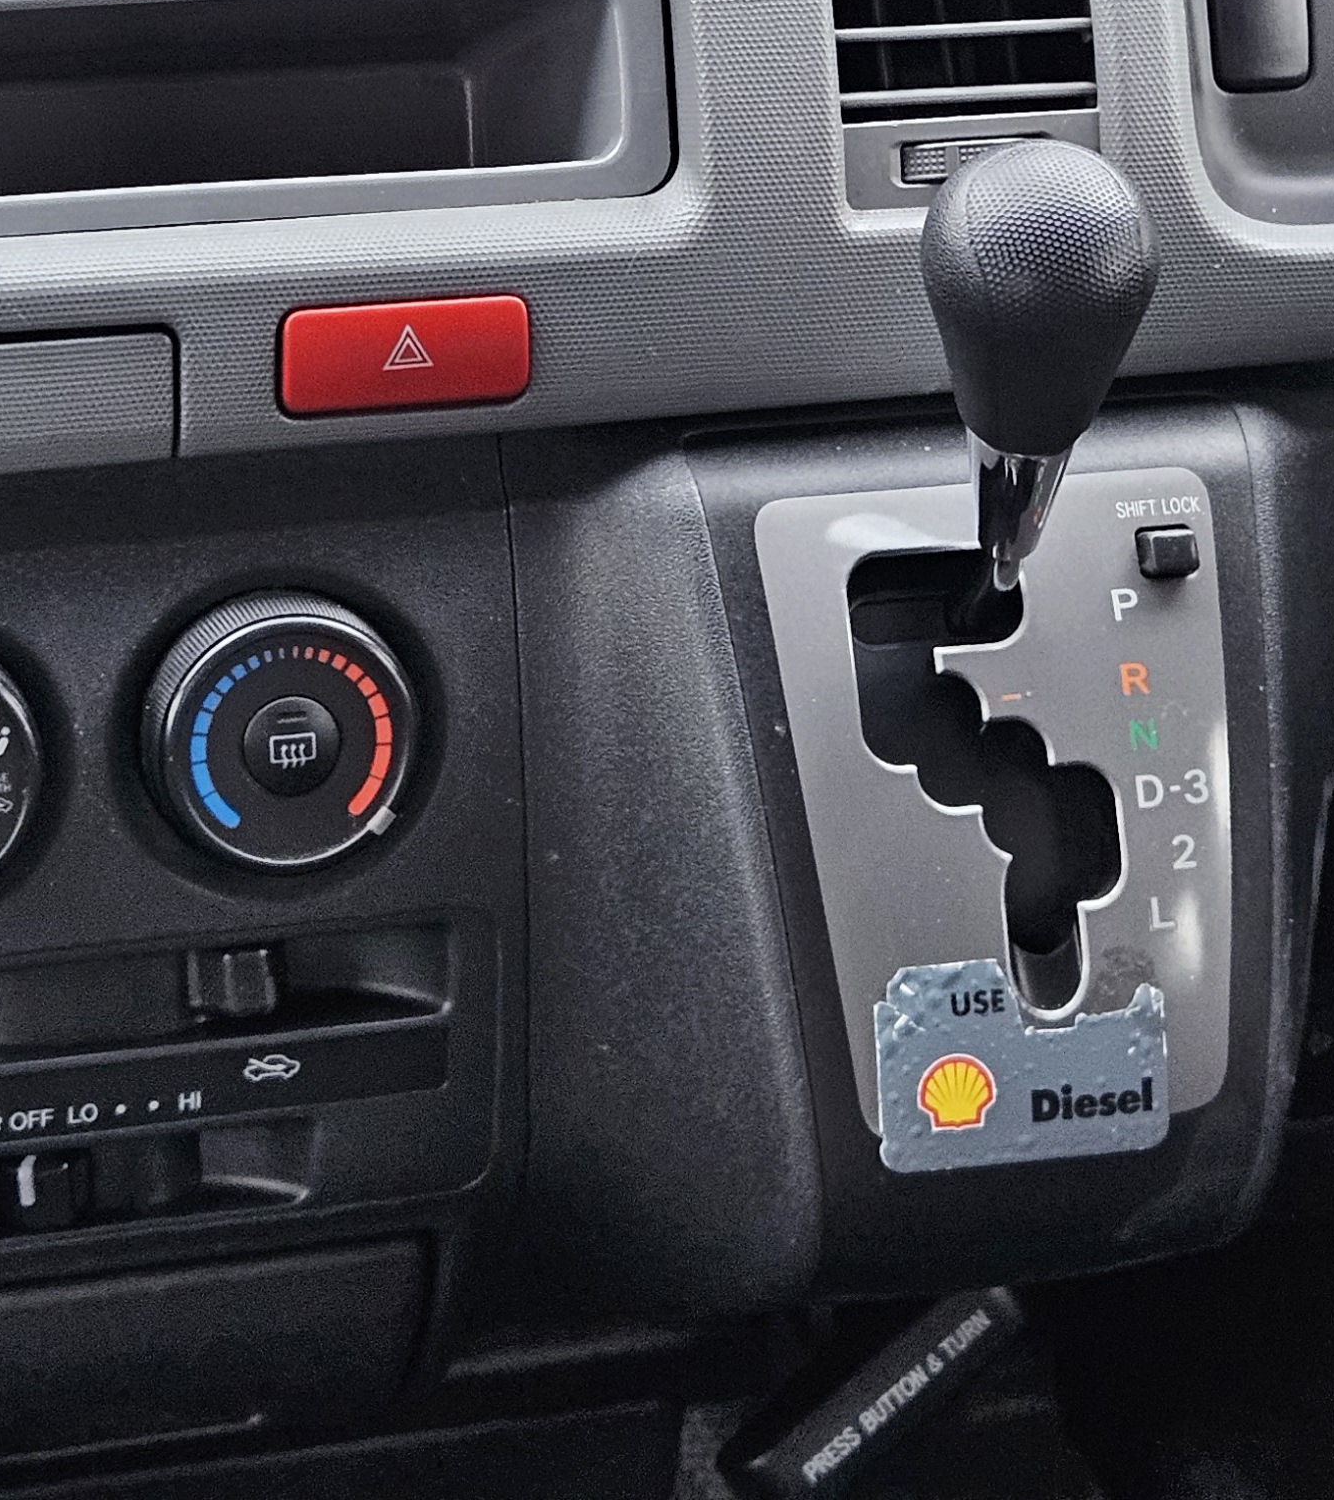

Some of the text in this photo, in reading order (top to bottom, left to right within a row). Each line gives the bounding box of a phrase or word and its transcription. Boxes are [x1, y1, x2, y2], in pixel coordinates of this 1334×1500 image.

[1115, 495, 1201, 519] SHIFT LOCK
[1110, 588, 1139, 622] P
[1120, 662, 1151, 696] R
[1129, 718, 1159, 750] N
[1171, 835, 1198, 869] 2
[1149, 896, 1176, 932] L
[950, 988, 1006, 1017] USE
[9, 1091, 202, 1132] OFF LO HI
[1030, 1076, 1154, 1123] Diesel
[802, 1309, 992, 1484] PRESS BUTTON & TURN
